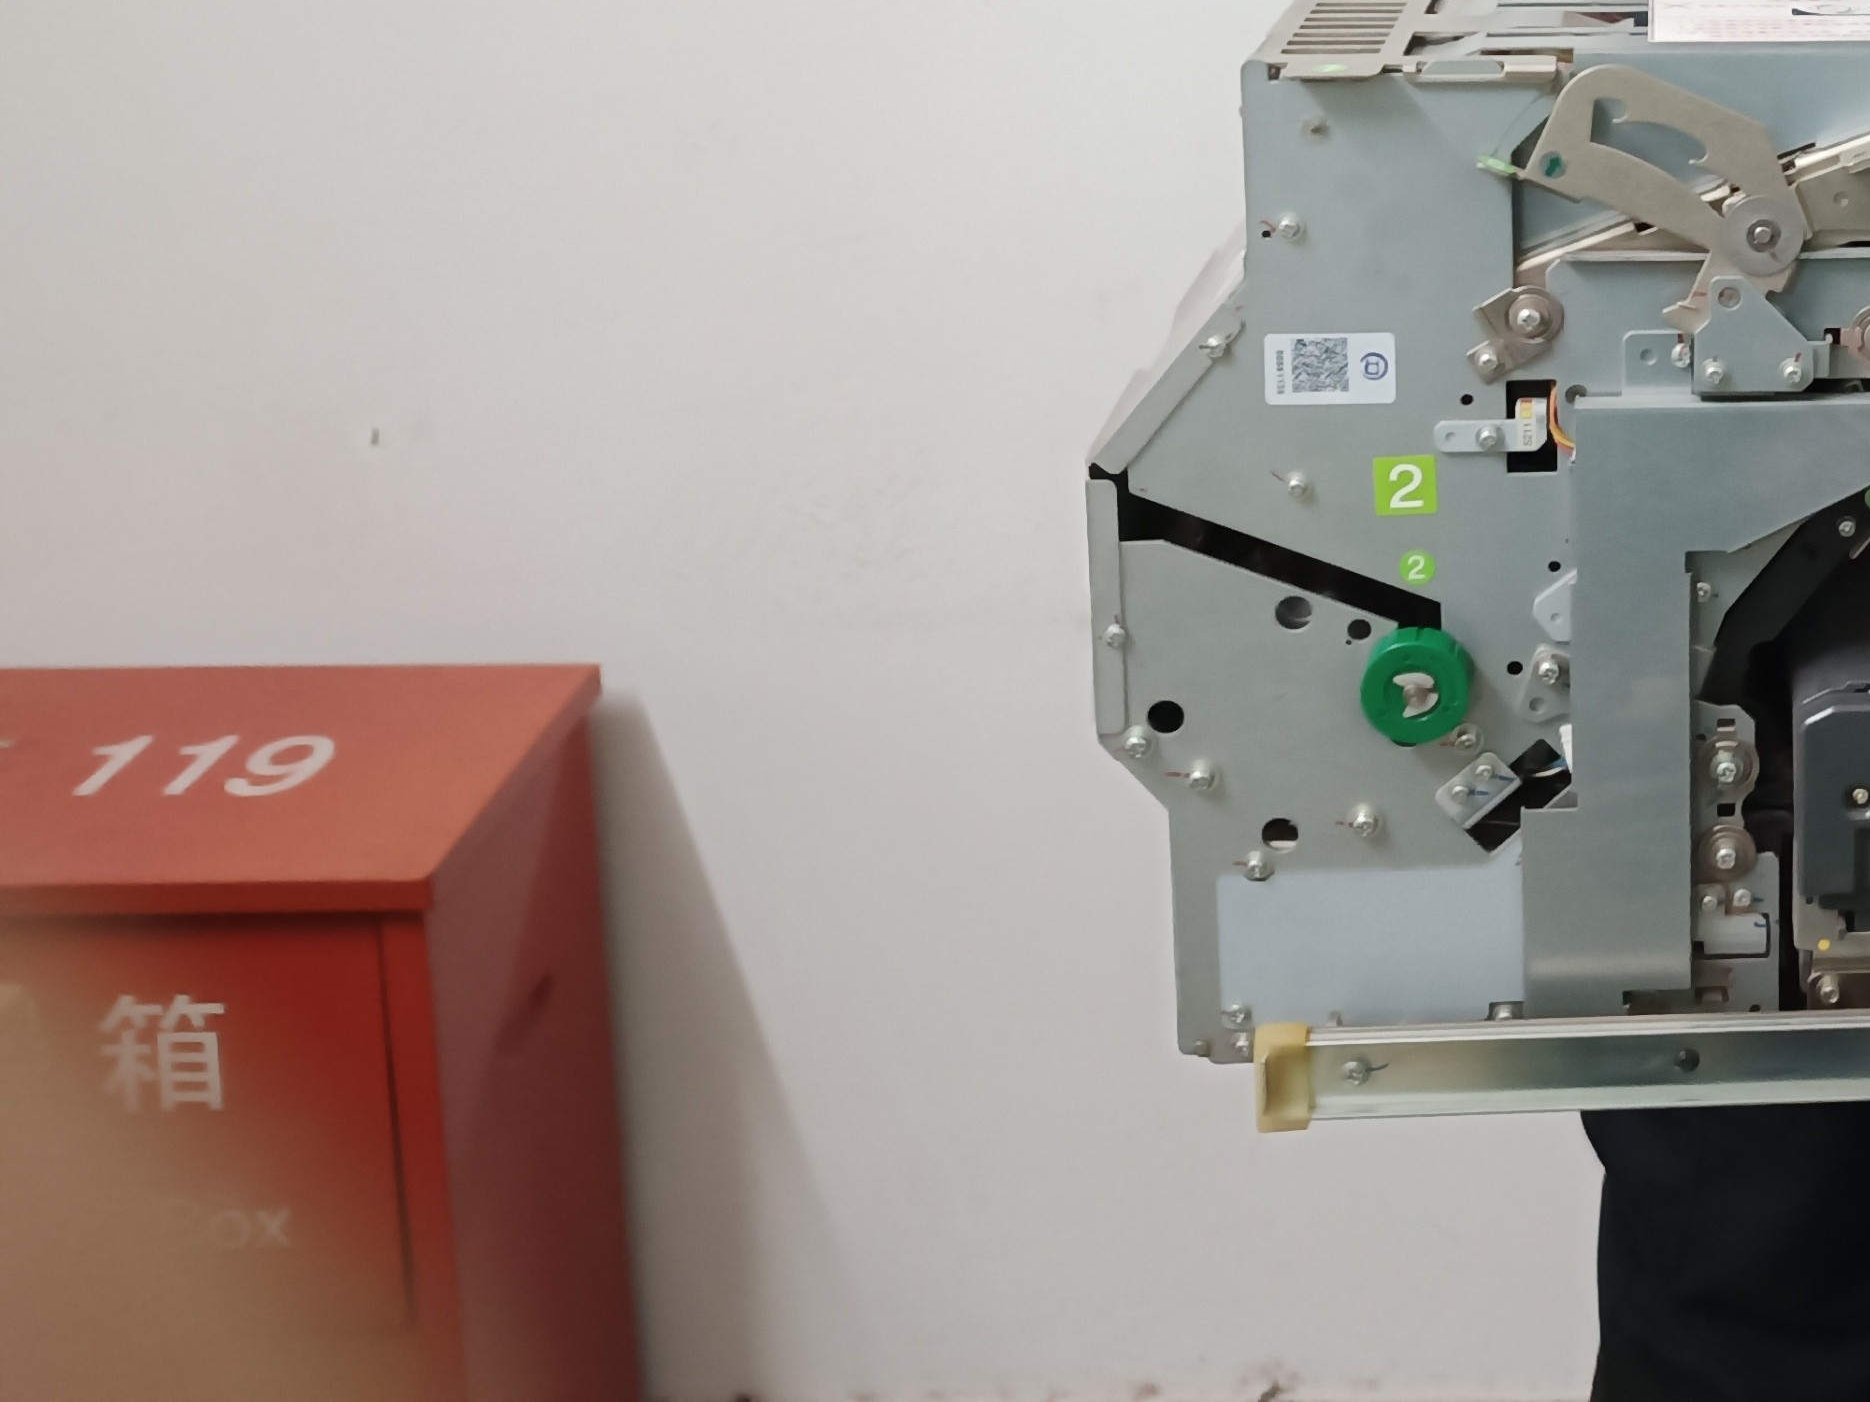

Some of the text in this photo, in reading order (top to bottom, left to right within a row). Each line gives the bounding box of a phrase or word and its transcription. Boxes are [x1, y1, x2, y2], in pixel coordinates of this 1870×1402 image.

[1390, 463, 1425, 509] 2
[1407, 554, 1426, 580] 2
[71, 734, 337, 798] 119
[98, 993, 227, 1112] 箱
